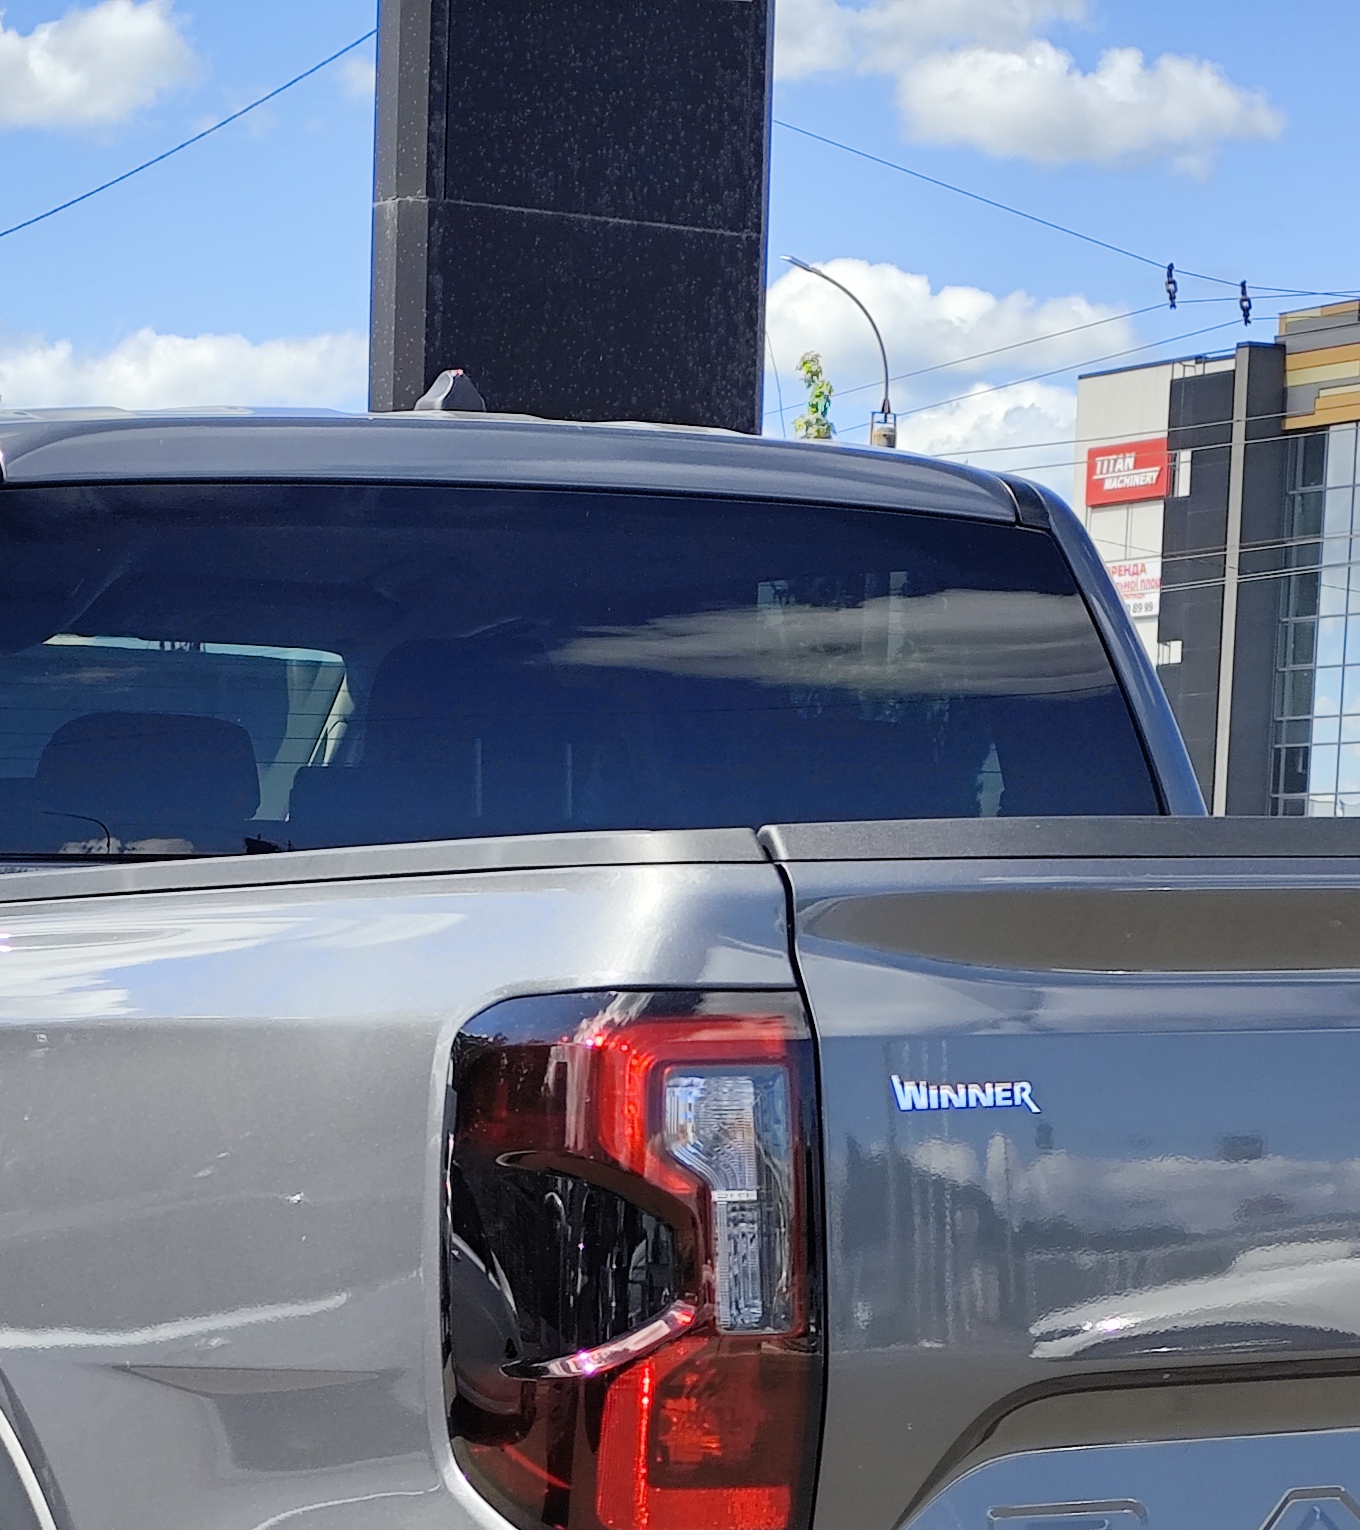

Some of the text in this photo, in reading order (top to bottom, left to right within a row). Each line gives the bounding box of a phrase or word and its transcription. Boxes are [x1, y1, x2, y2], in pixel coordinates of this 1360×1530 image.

[1095, 452, 1136, 475] TITAN
[1104, 471, 1159, 491] MACHINERY
[890, 1074, 1041, 1113] WINNER
